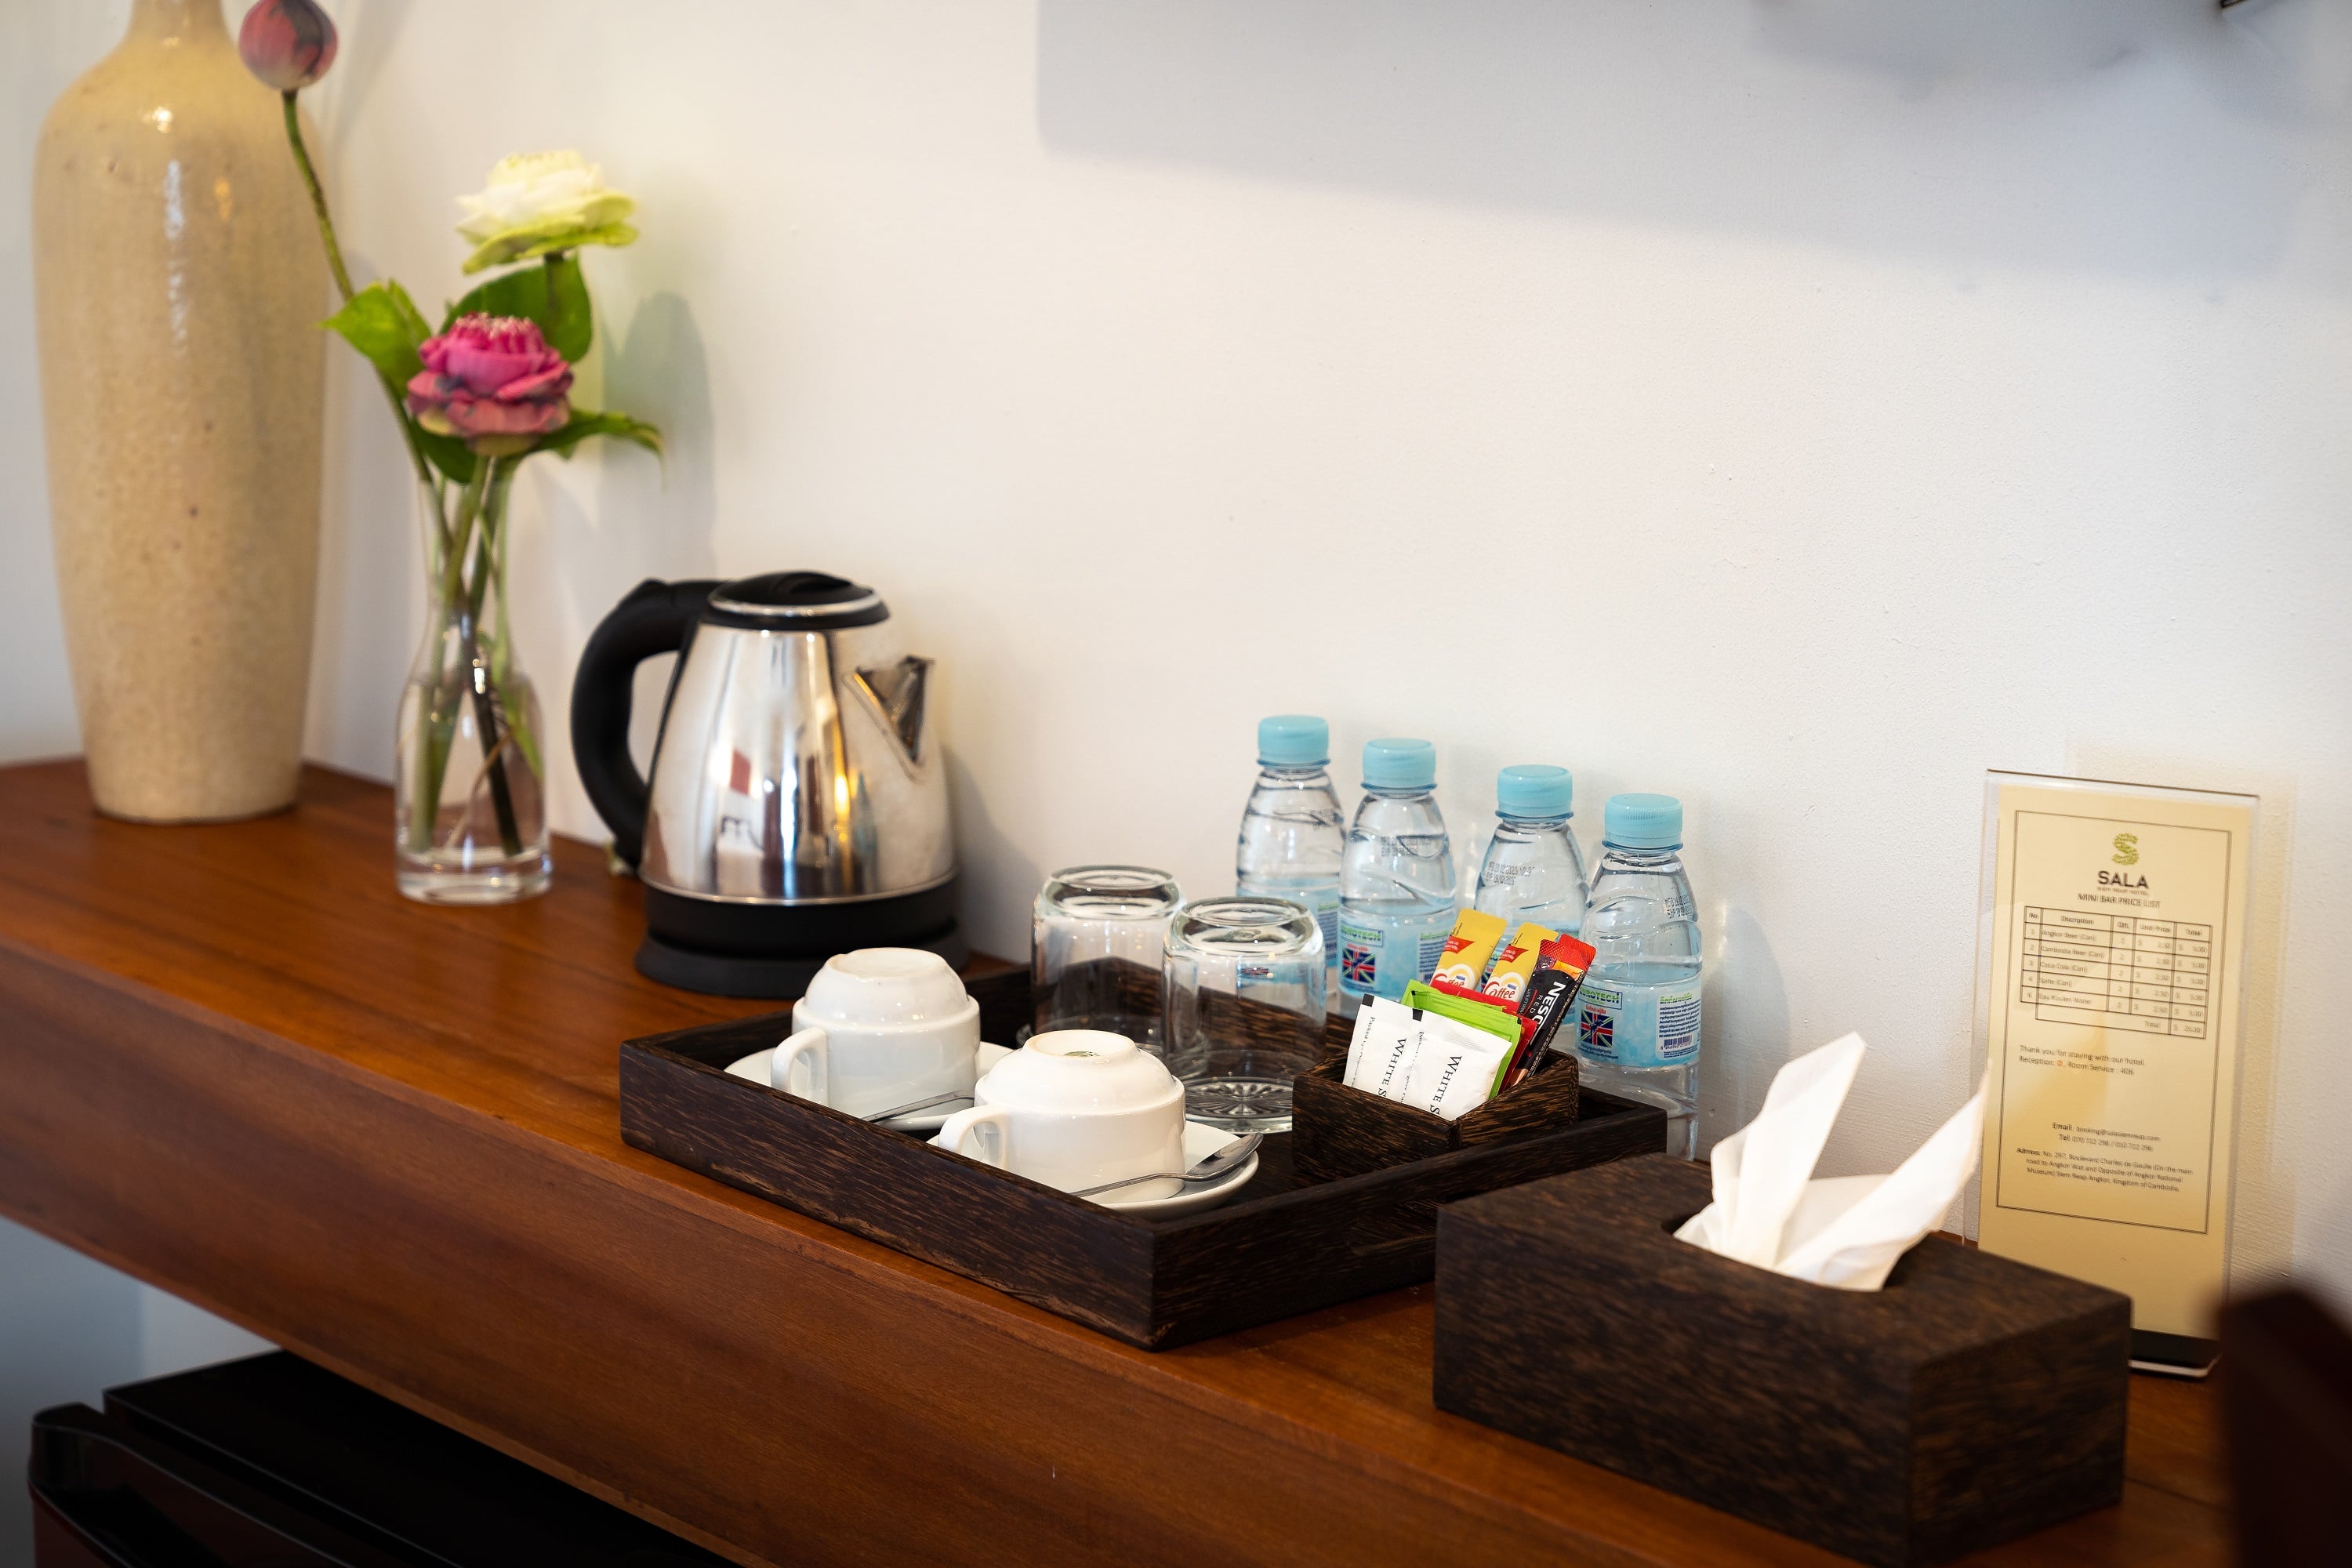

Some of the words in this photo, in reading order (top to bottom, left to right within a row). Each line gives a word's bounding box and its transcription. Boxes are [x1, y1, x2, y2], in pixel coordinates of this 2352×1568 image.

[2097, 869, 2150, 889] SALA
[2077, 893, 2098, 902] MINI
[2099, 895, 2117, 904] BAR
[2118, 897, 2141, 906] PRICE
[2142, 899, 2161, 908] LIST
[1530, 994, 1544, 1014] RED
[1531, 981, 1566, 1025] NESC
[1579, 986, 1620, 1004] EUROTECH
[1381, 1037, 1407, 1086] WHITE
[2019, 1044, 2040, 1053] Thank
[2067, 1051, 2092, 1059] staying
[1433, 1055, 1462, 1103] WHITE
